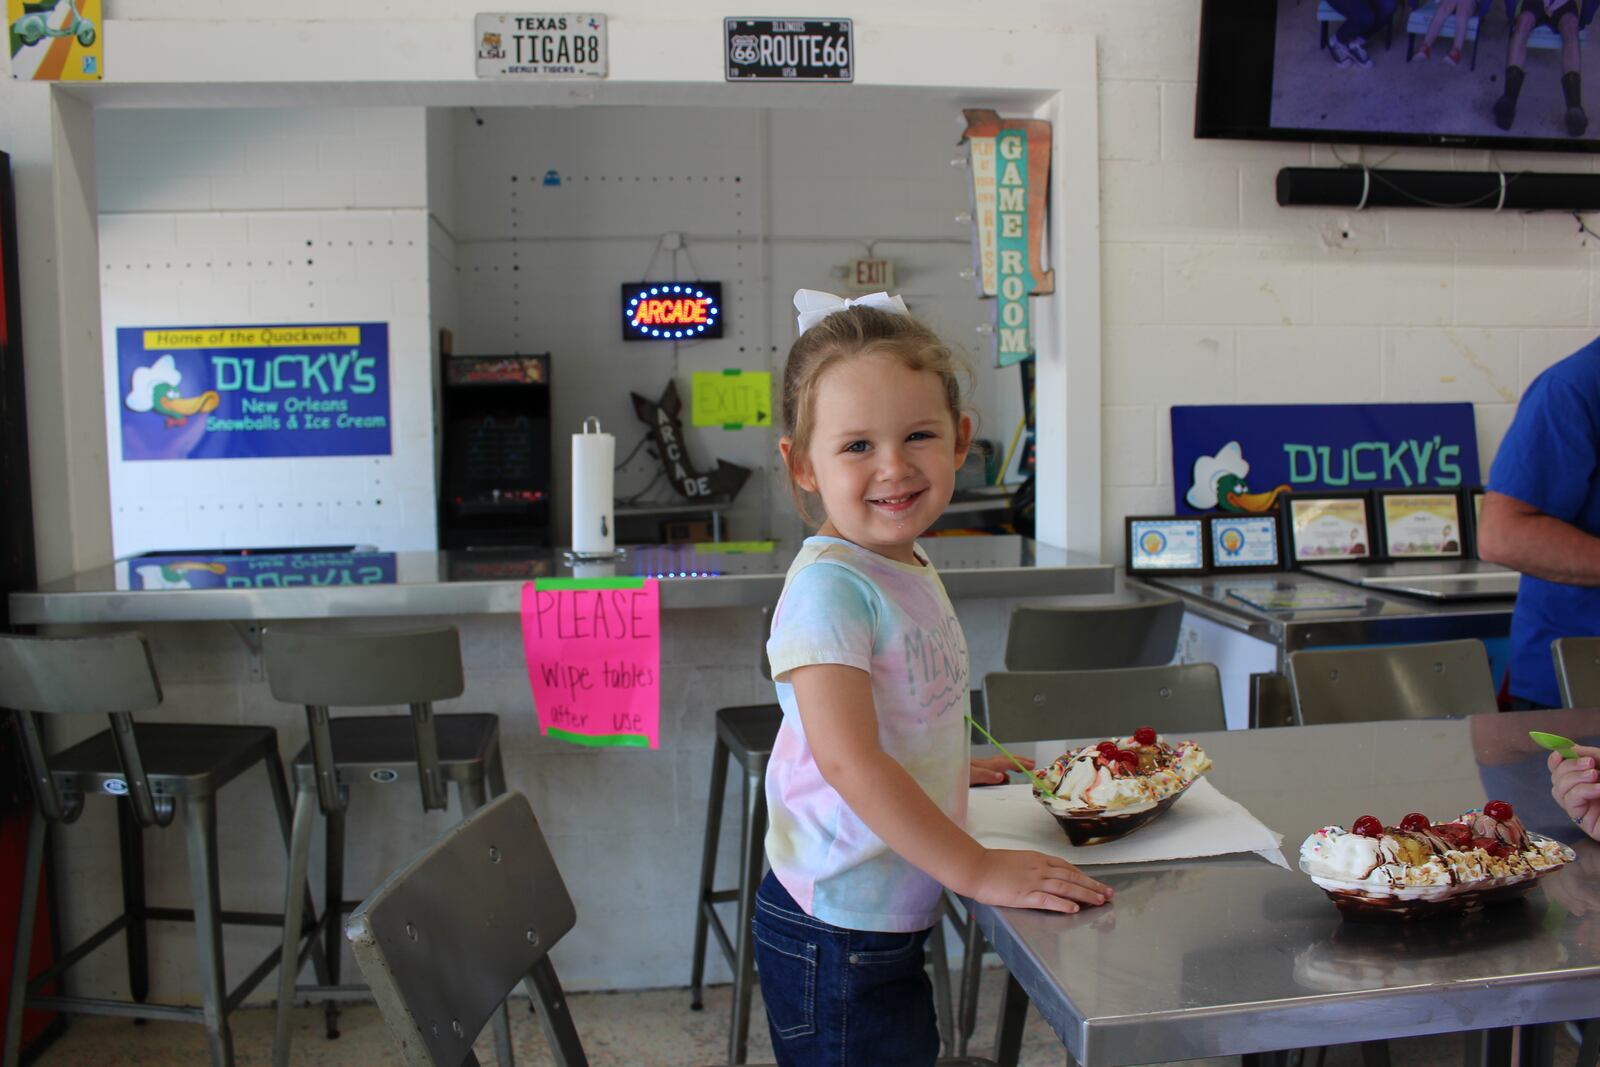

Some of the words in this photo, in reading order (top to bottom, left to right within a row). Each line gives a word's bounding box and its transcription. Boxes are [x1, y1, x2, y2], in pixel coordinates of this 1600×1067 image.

[514, 18, 567, 30] TEXAS
[479, 49, 506, 59] LSU
[512, 35, 599, 63] TIGAB8
[735, 45, 756, 60] 66
[760, 34, 848, 66] ROUTE66
[999, 136, 1025, 237] GAME
[856, 261, 887, 285] EXIT
[634, 299, 708, 324] ARCADE
[1000, 250, 1028, 353] ROOM
[157, 333, 204, 346] Home
[209, 331, 225, 344] of
[229, 331, 255, 344] the
[260, 328, 348, 346] Quackwich
[242, 398, 278, 413] New
[284, 397, 348, 413] Orleans
[701, 382, 751, 414] EXIT
[206, 415, 281, 432] Snowballs
[286, 415, 298, 429] &
[304, 414, 331, 429] Ice
[336, 413, 386, 428] Cream
[656, 408, 712, 496] ARCADE
[535, 591, 651, 639] PLEASE
[602, 660, 654, 689] tables
[551, 705, 589, 728] after
[613, 713, 643, 732] use
